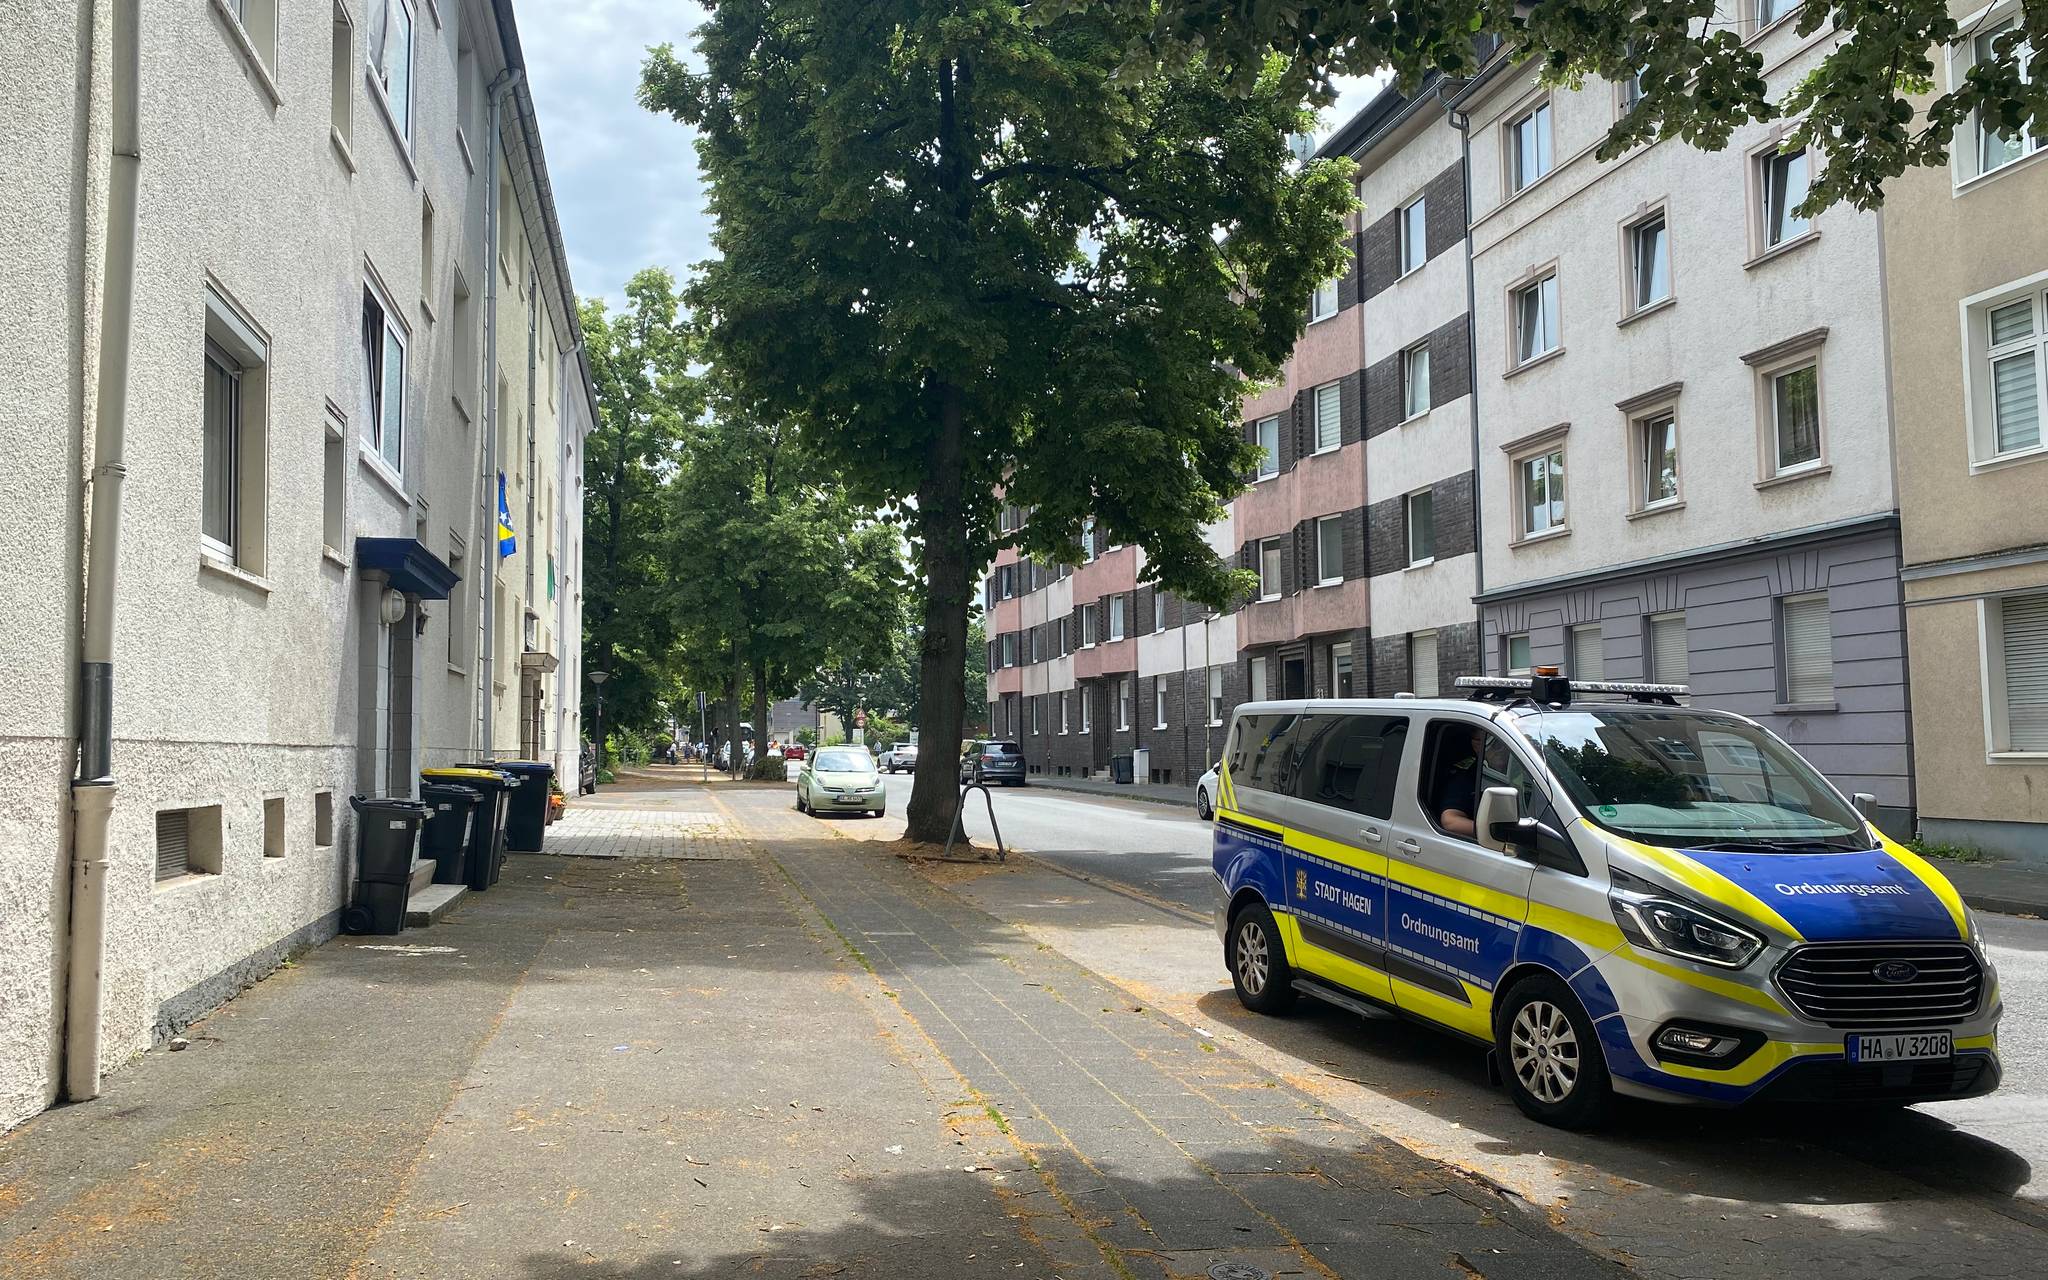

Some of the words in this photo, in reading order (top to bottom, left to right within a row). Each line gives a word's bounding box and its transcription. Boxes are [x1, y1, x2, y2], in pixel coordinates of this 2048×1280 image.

[1314, 880, 1341, 903] STADT
[1342, 890, 1372, 916] HAGEN
[1774, 882, 1911, 897] Ordnungsamt
[1401, 912, 1480, 954] Ordnungsamt
[1861, 1038, 1883, 1059] HA
[1895, 1037, 1906, 1058] V
[1909, 1035, 1949, 1057] 3208
